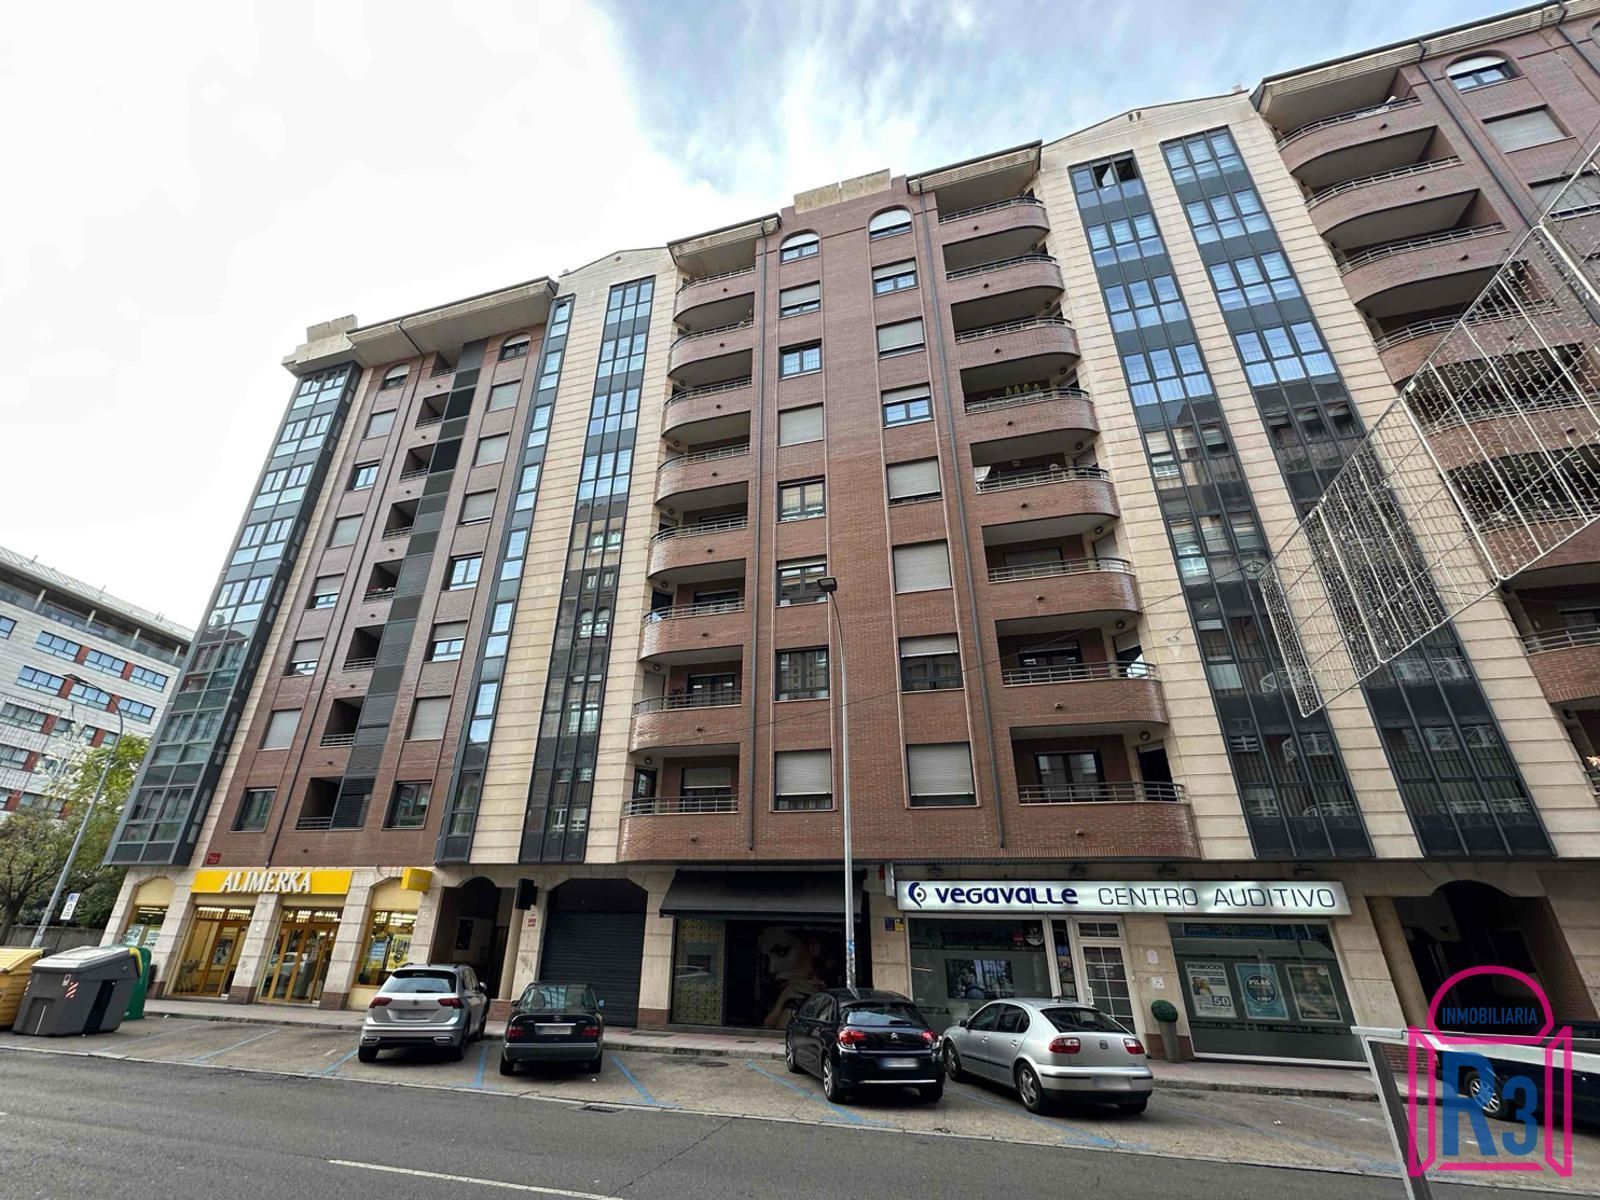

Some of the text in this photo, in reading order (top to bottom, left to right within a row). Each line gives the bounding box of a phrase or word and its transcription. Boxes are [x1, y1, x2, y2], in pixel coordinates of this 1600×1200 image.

[220, 870, 312, 894] ALIMERKA
[1097, 887, 1199, 906] CENTRO
[1213, 887, 1336, 908] AUDITIVO
[1213, 996, 1230, 1006] 50
